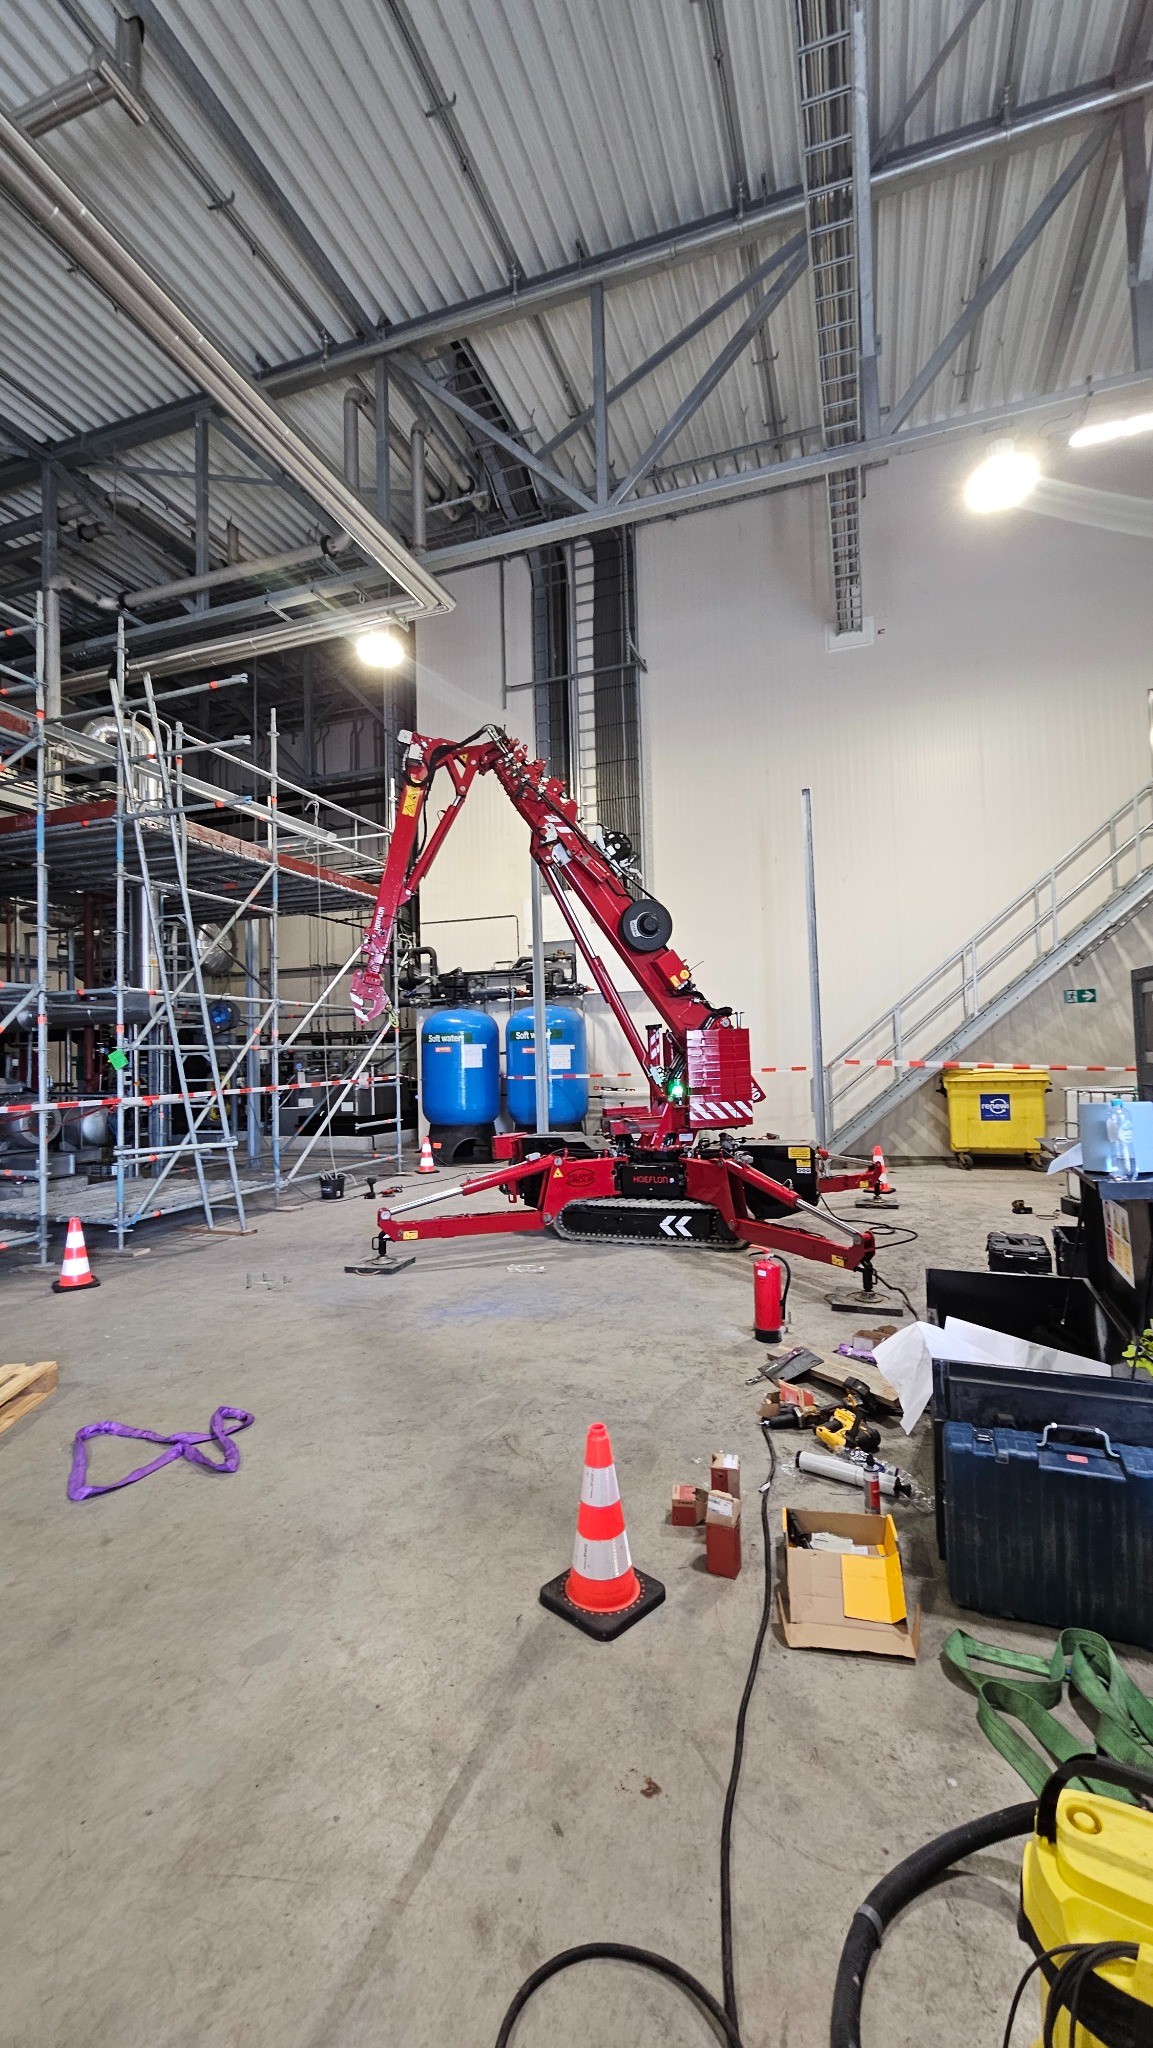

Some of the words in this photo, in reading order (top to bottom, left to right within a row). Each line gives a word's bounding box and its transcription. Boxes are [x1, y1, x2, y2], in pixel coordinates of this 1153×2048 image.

[428, 1034, 441, 1043] Soft
[441, 1033, 463, 1042] water
[515, 1031, 529, 1040] Soft
[632, 1175, 669, 1184] HOEFLON
